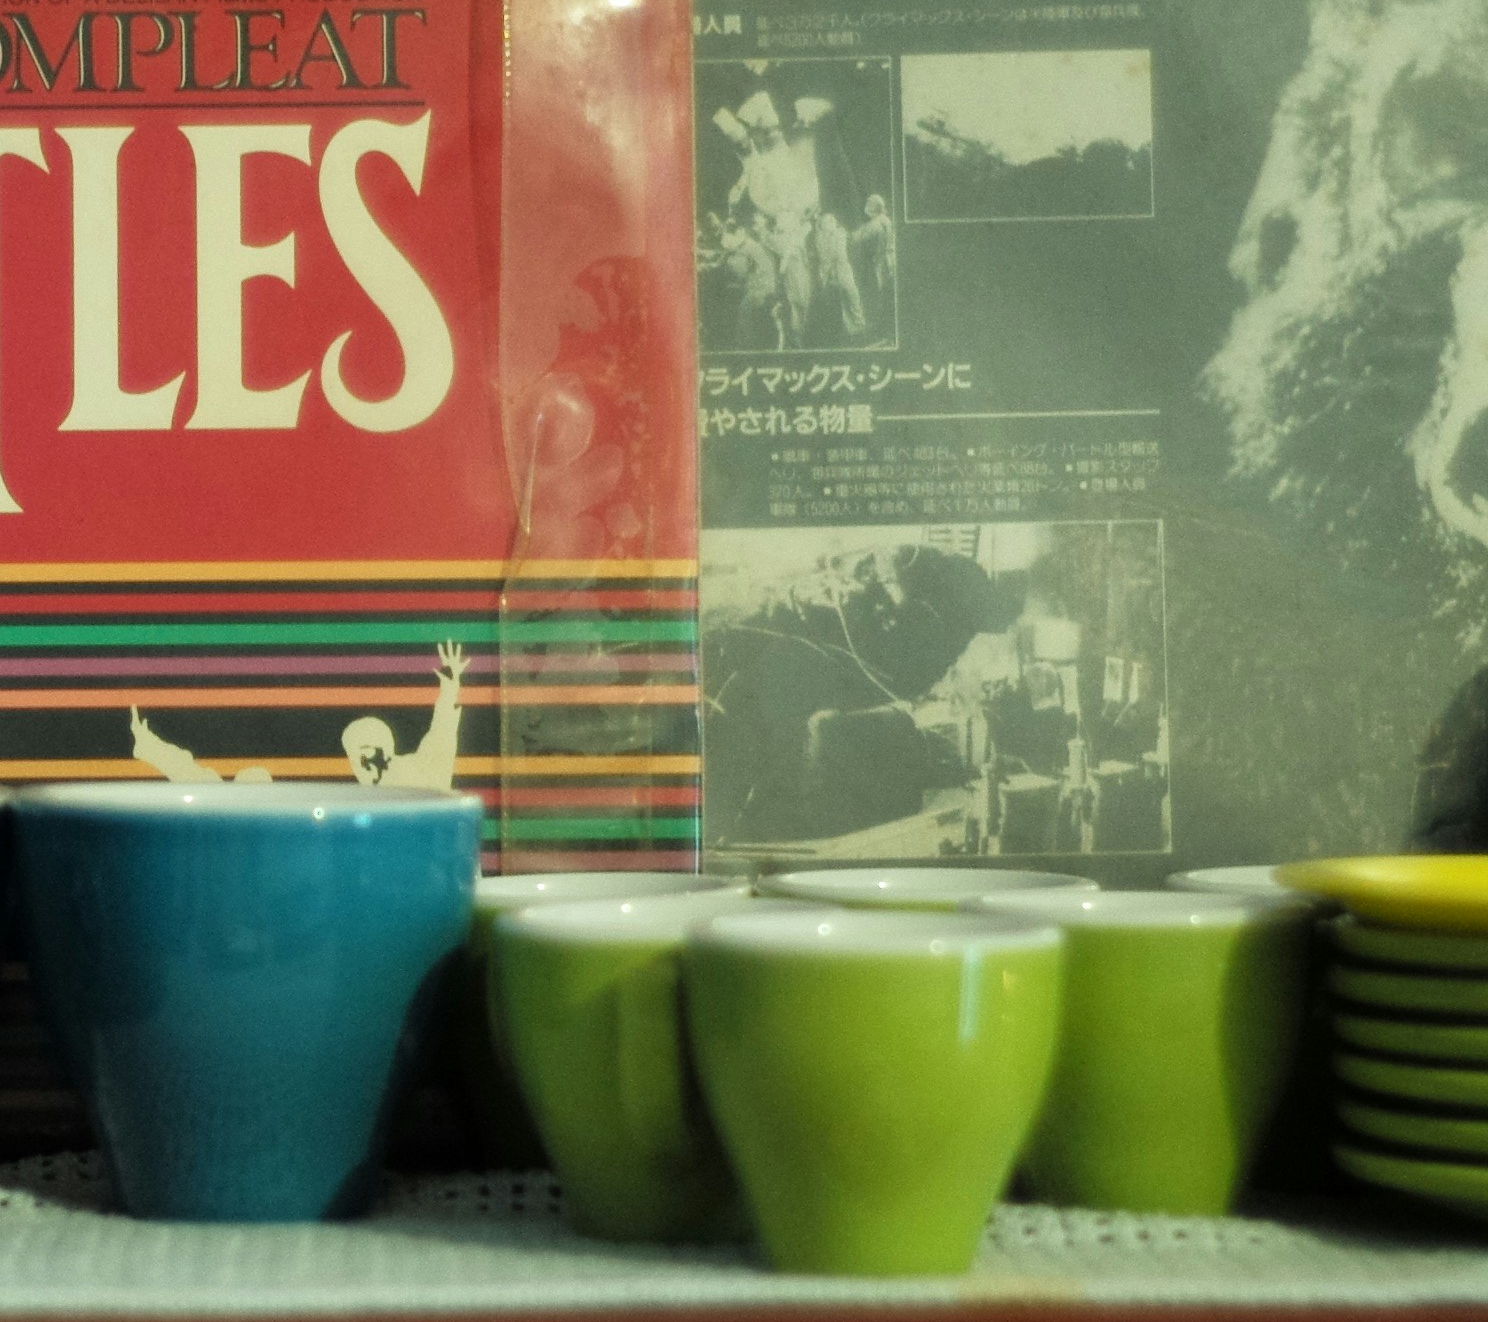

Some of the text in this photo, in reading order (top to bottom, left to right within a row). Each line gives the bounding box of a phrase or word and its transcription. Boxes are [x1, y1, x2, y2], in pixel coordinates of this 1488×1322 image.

[698, 362, 972, 396] ライマックス・シーンに
